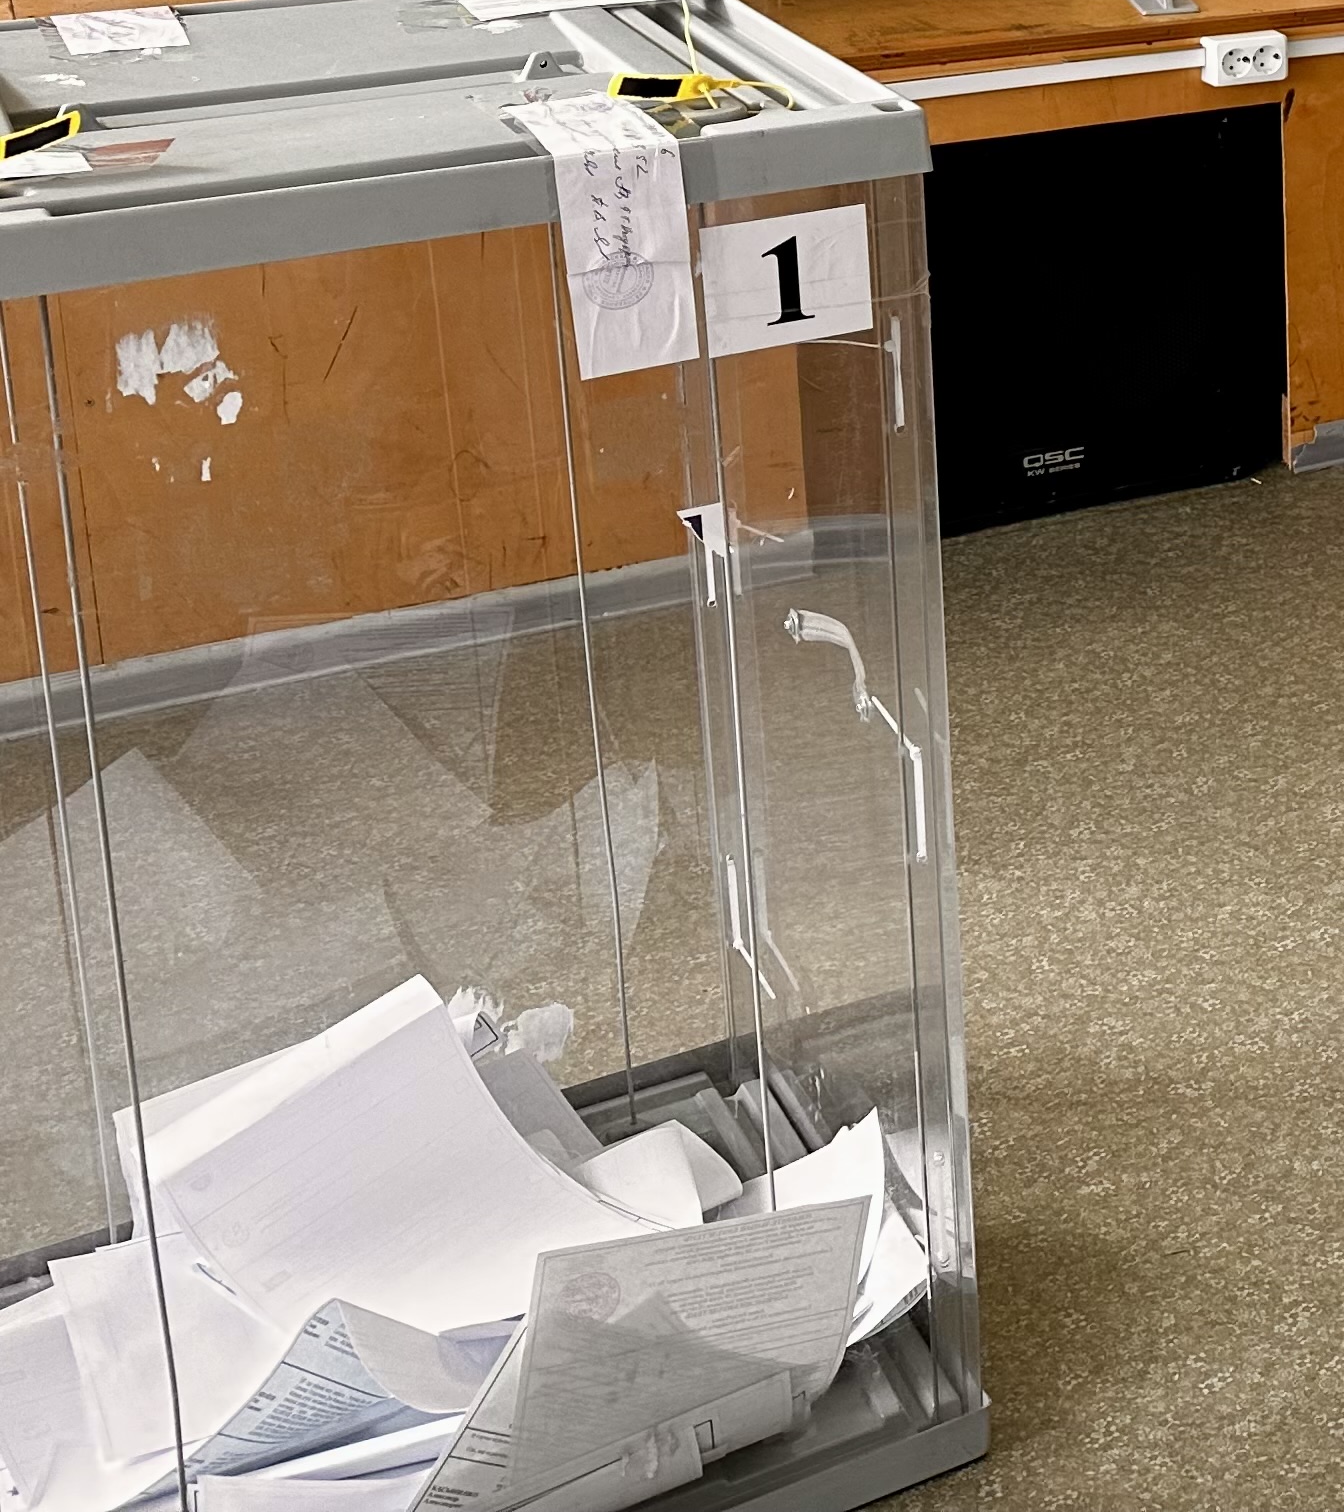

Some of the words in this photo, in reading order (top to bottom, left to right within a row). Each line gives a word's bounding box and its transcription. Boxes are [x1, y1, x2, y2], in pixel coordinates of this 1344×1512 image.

[761, 235, 816, 327] 1
[1023, 446, 1085, 468] QSC
[1027, 468, 1045, 477] KW
